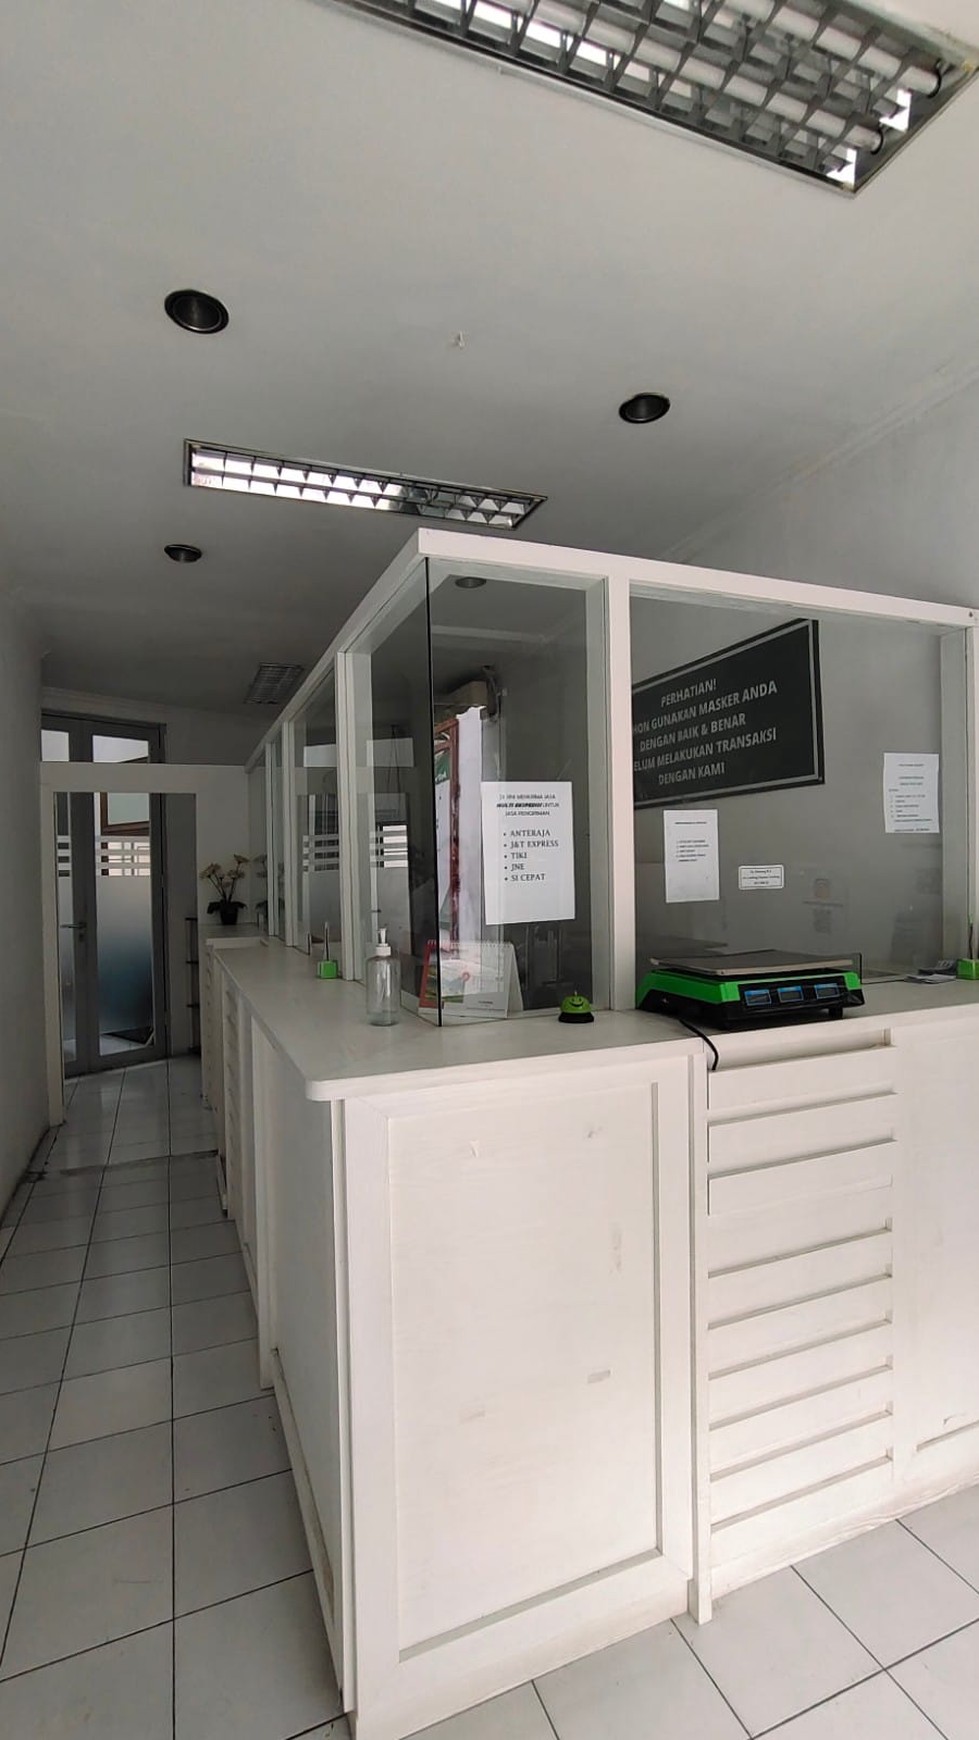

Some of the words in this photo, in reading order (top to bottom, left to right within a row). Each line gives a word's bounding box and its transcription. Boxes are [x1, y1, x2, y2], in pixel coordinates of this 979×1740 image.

[660, 678, 717, 707] PERHATIAN!
[651, 706, 697, 730] GUNAKAN
[699, 692, 740, 716] MASKER
[741, 680, 778, 703] ANDA
[640, 732, 680, 752] DENGAN
[678, 725, 699, 742] BAIK
[701, 723, 708, 736] &
[711, 713, 747, 733] BENAR
[657, 742, 714, 767] MELAKUKAN
[715, 727, 777, 753] TRANSAKSI
[658, 765, 696, 785] DENGAN
[697, 762, 725, 779] KAMI
[510, 829, 551, 837] ANTERAJA
[510, 840, 525, 849] J&T
[511, 863, 525, 871] JNE
[520, 873, 545, 881] CEPAT
